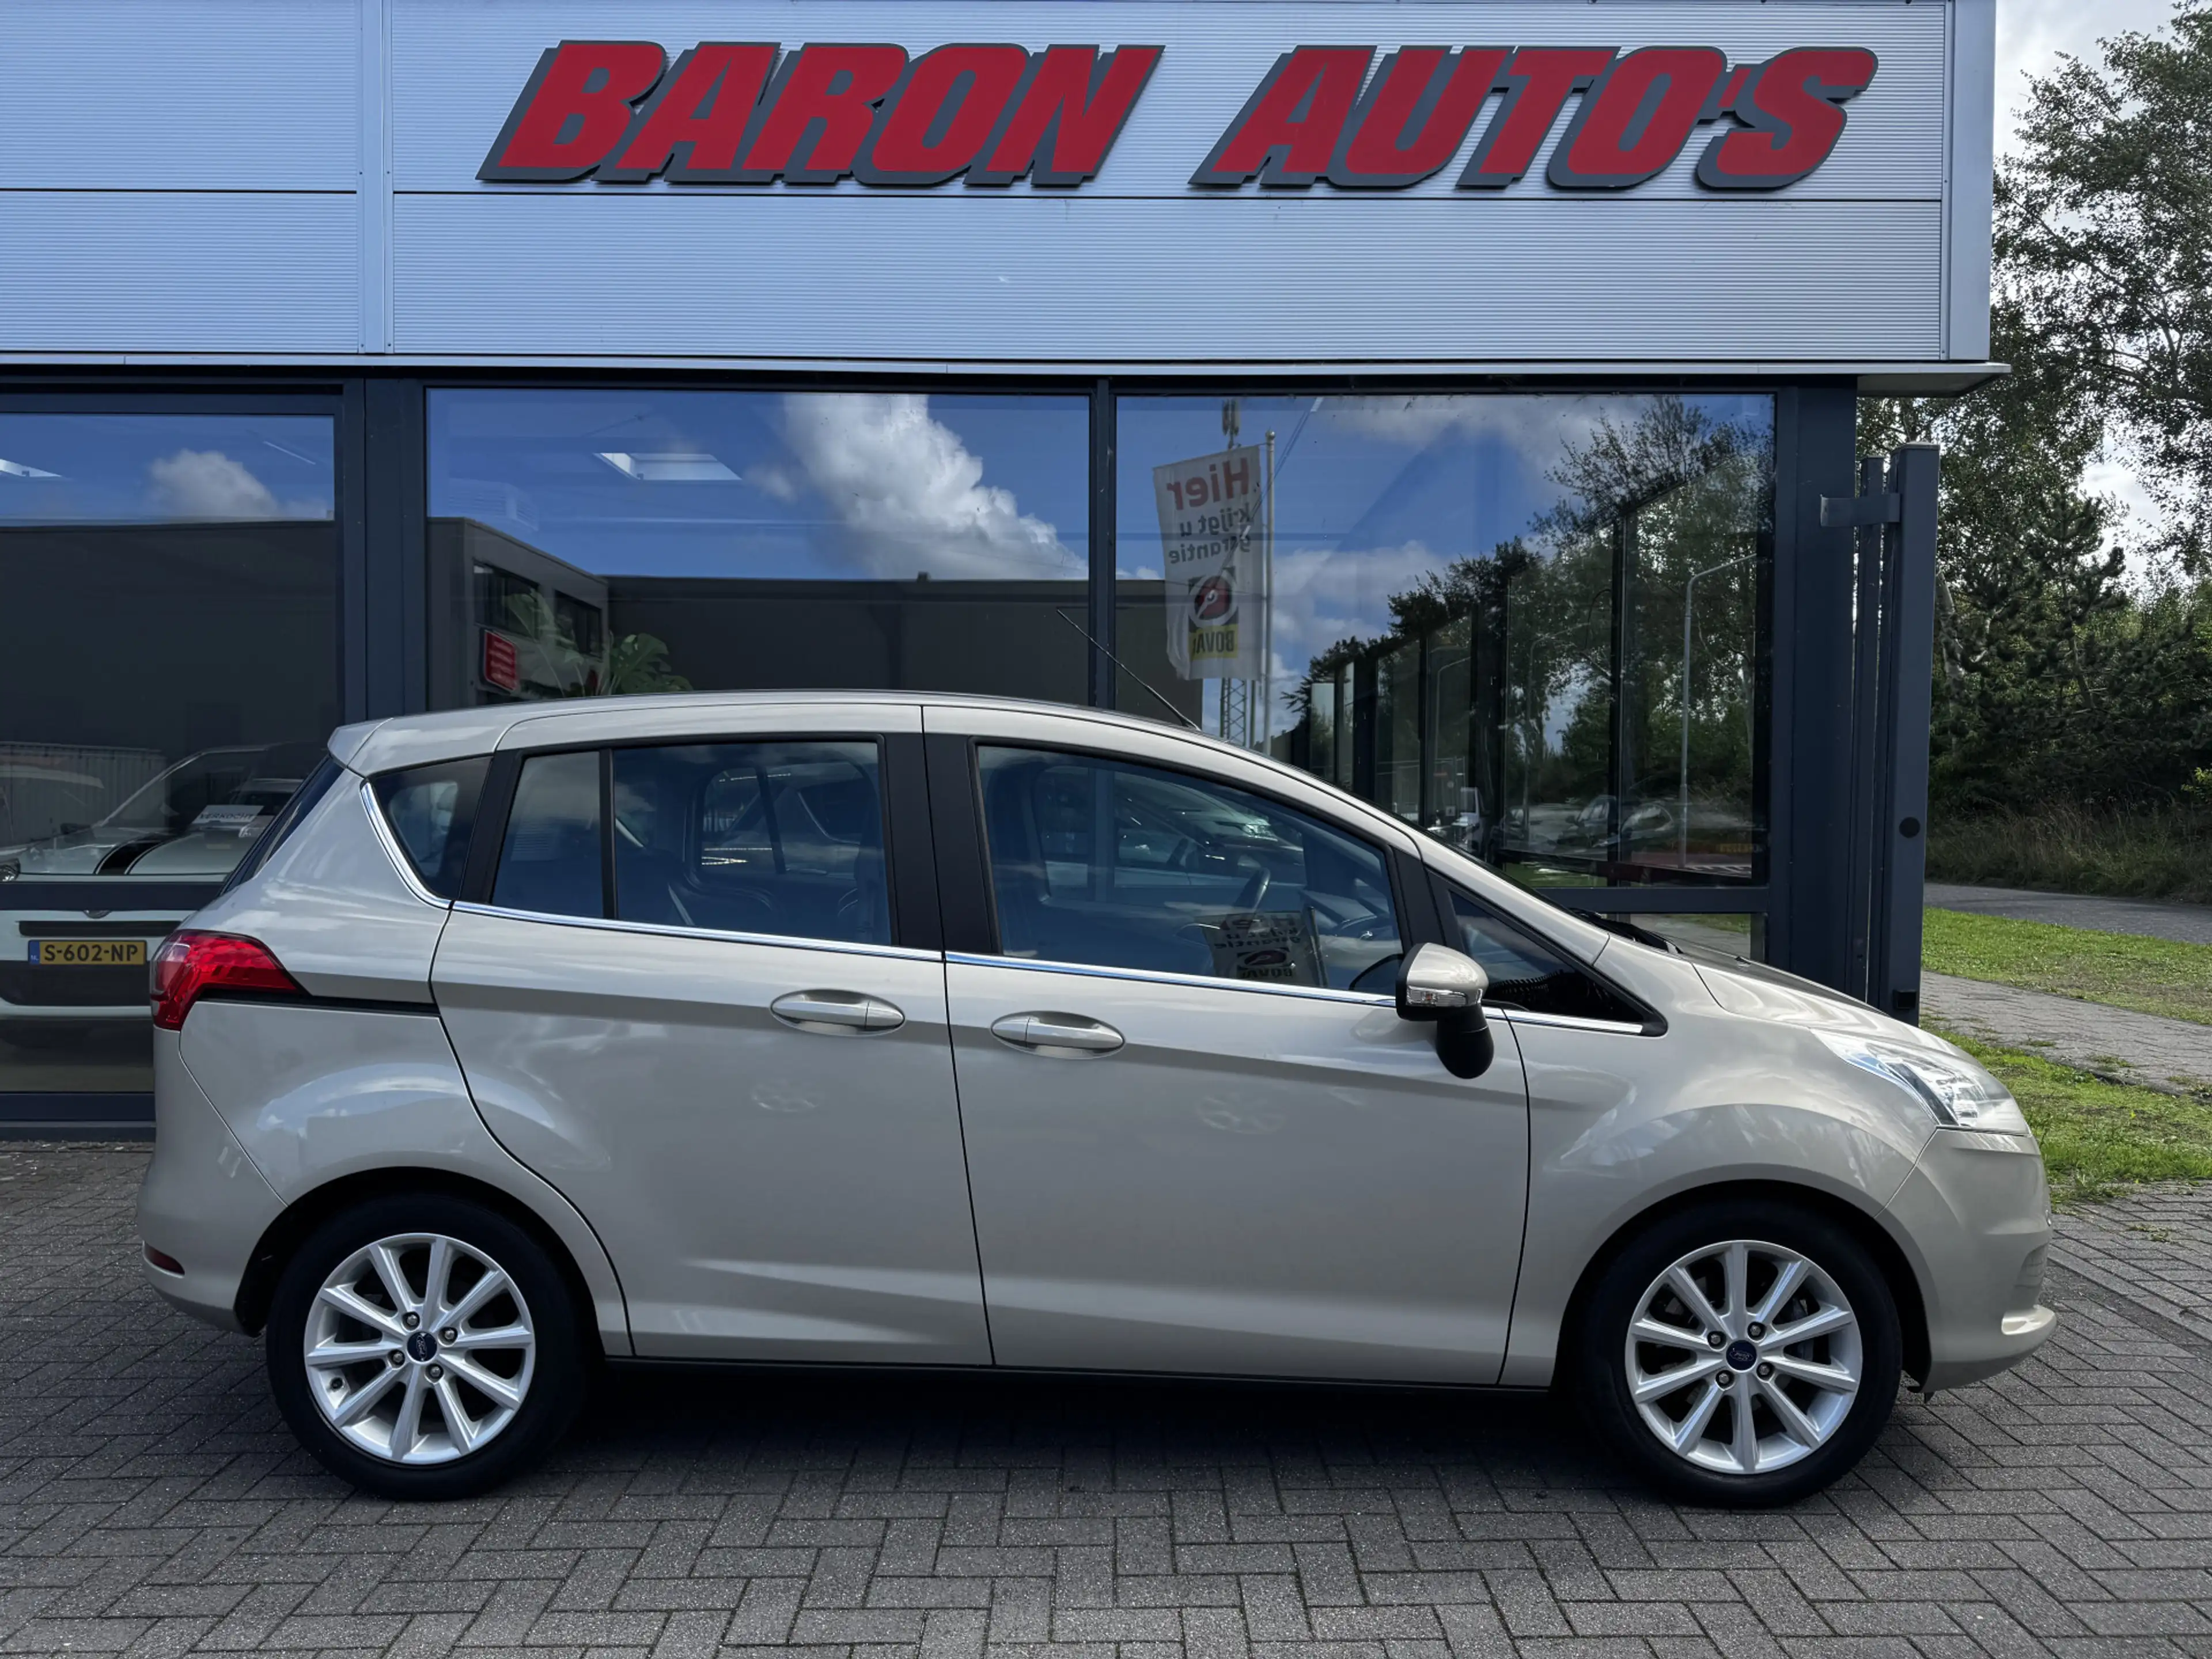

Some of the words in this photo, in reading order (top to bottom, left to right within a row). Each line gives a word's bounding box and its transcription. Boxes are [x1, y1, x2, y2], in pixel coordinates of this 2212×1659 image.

[491, 41, 1164, 176] BARON
[1205, 46, 1877, 179] AUTO'S
[44, 944, 138, 961] S-602-NP
